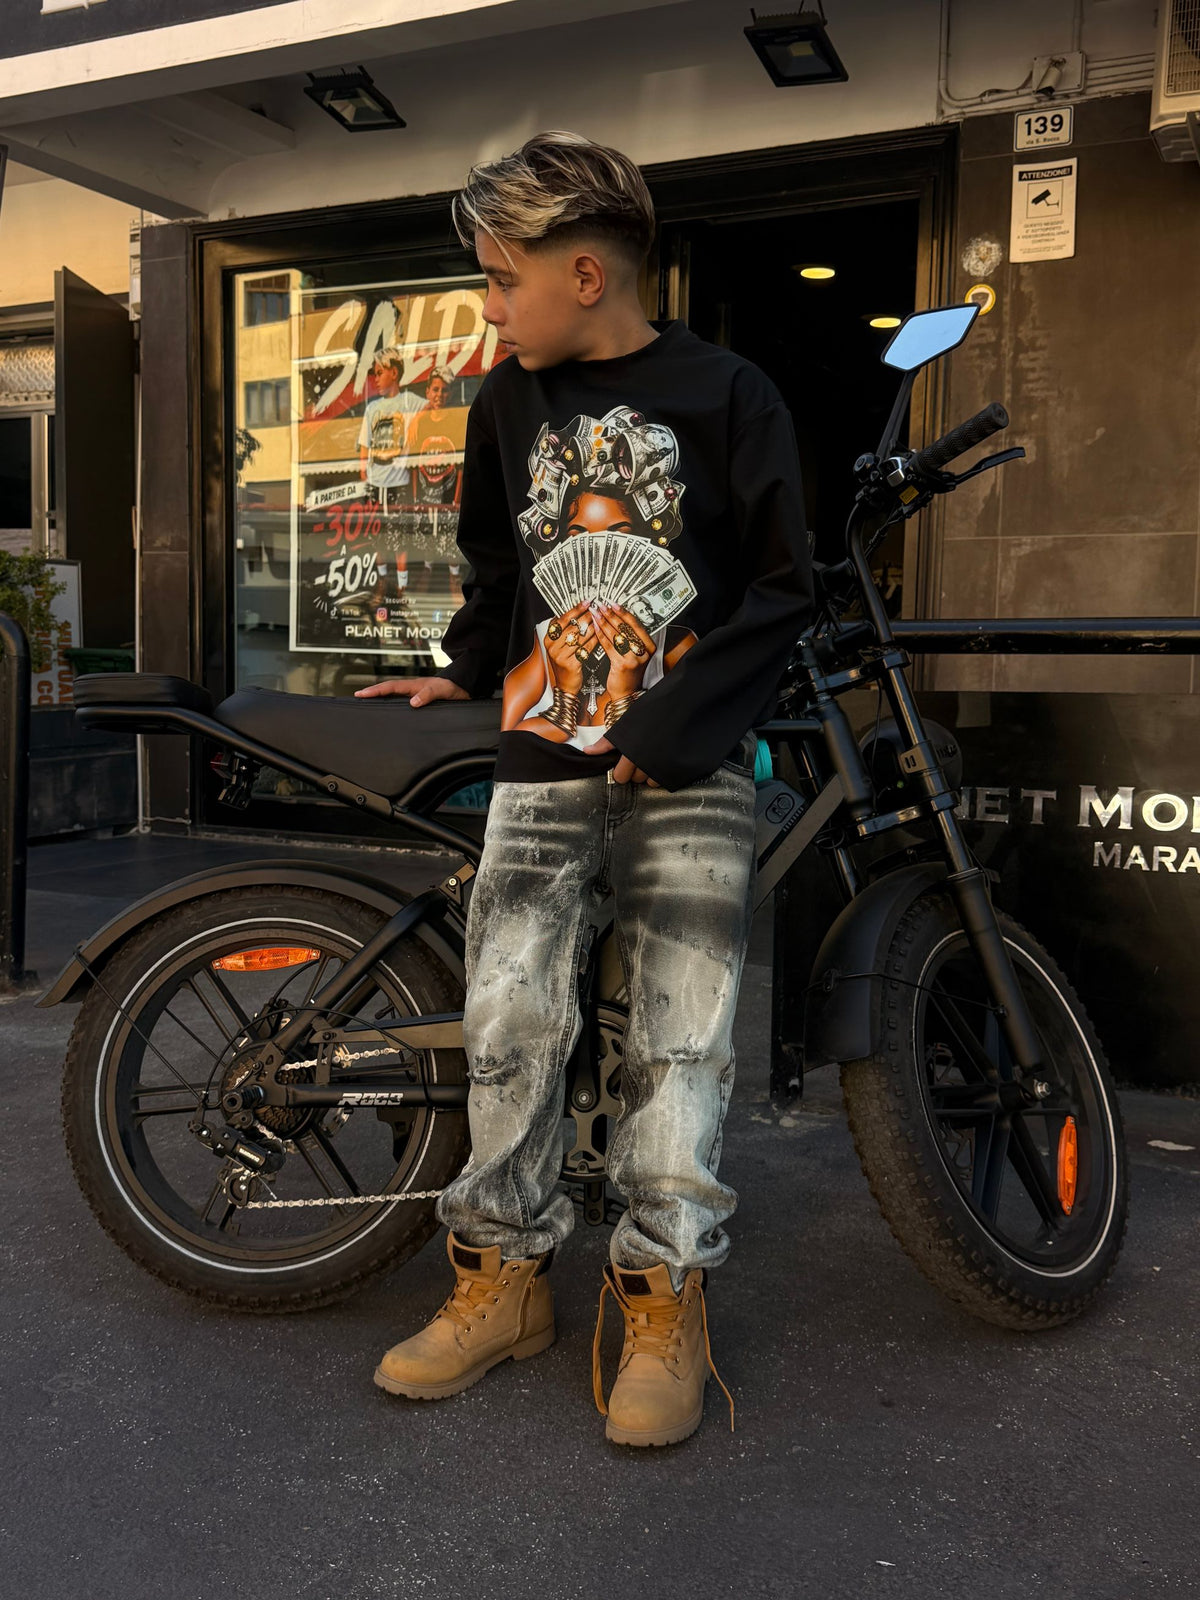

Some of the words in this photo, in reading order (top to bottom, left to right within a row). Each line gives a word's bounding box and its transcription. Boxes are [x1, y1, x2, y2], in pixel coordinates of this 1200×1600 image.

[1024, 114, 1064, 136] 139
[1021, 168, 1070, 180] ATTENZIONE!
[314, 289, 499, 417] SALDI
[320, 487, 347, 503] PARTIRE
[347, 485, 357, 496] DA
[313, 501, 381, 547] -30%
[340, 544, 347, 556] A
[314, 552, 378, 598] -50%
[345, 624, 402, 638] PLANET
